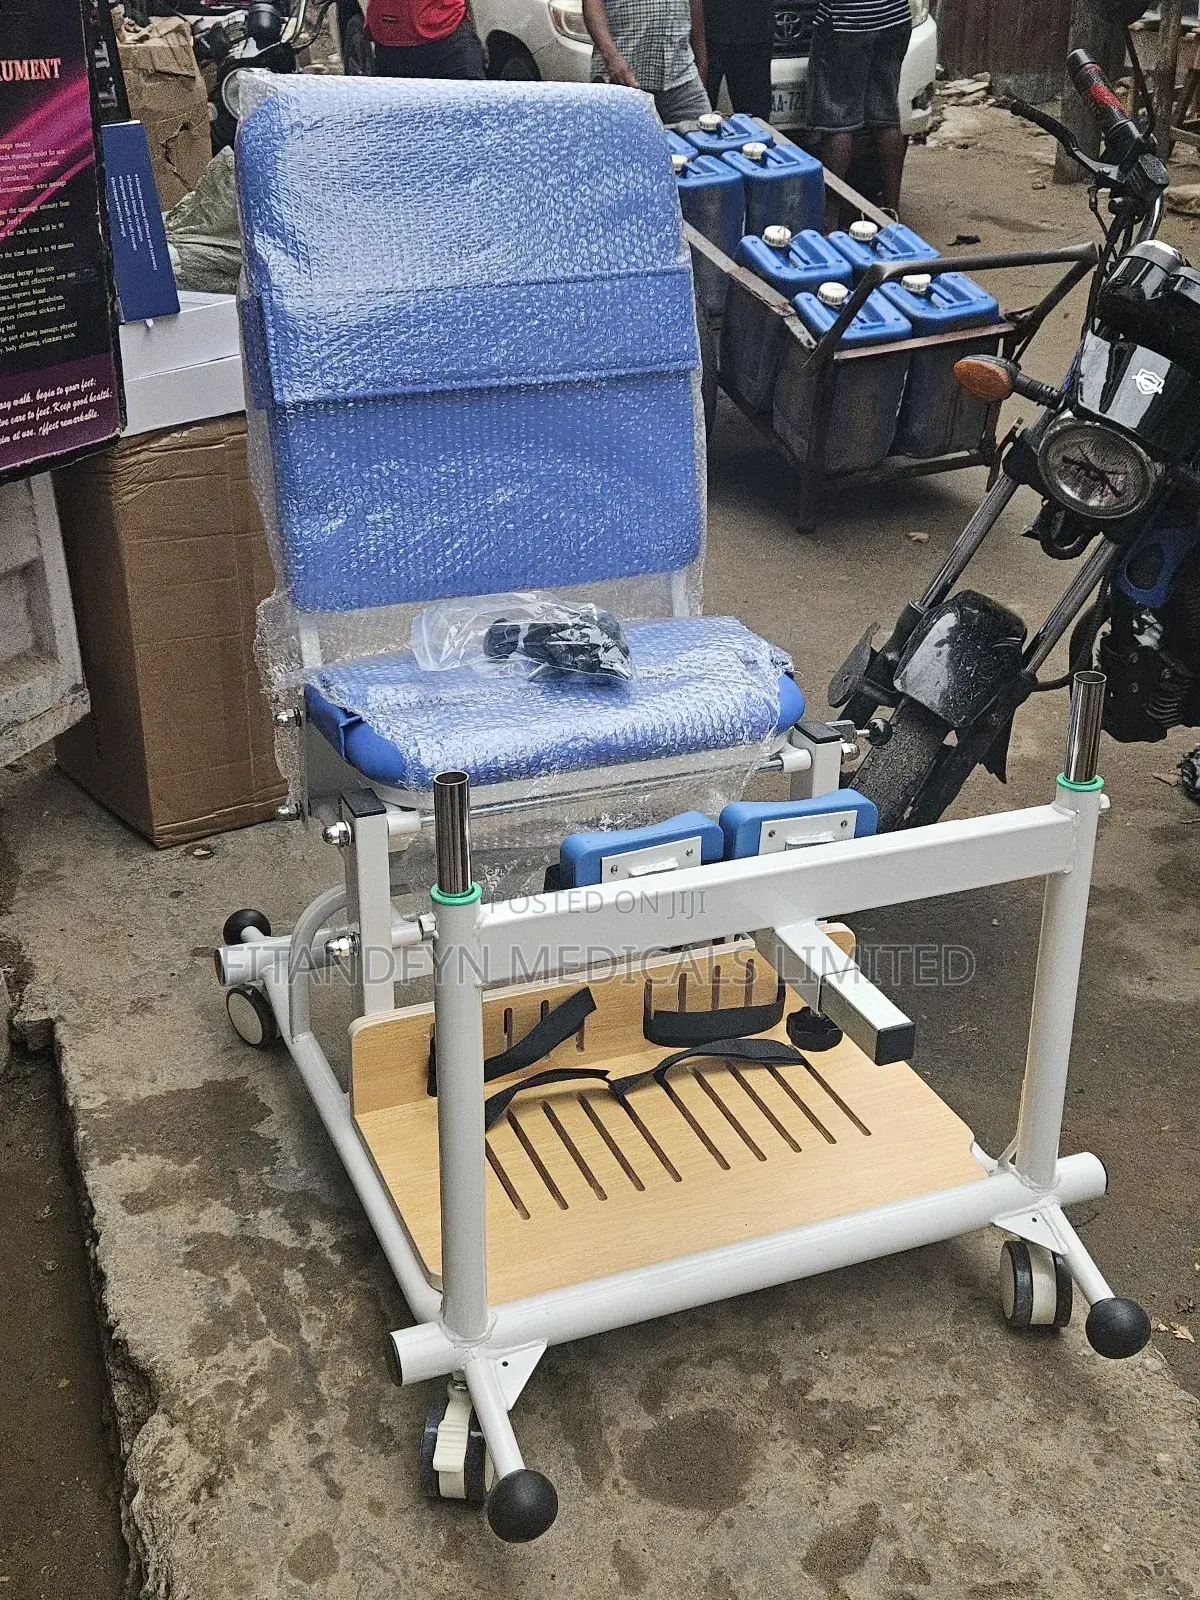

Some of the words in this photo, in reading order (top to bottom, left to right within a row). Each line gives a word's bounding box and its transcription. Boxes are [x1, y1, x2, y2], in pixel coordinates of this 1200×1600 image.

[0, 58, 61, 81] UMENT
[35, 388, 56, 402] begin
[56, 386, 64, 395] to
[64, 383, 80, 396] your
[10, 413, 27, 425] care
[27, 410, 35, 420] to
[72, 394, 89, 411] good
